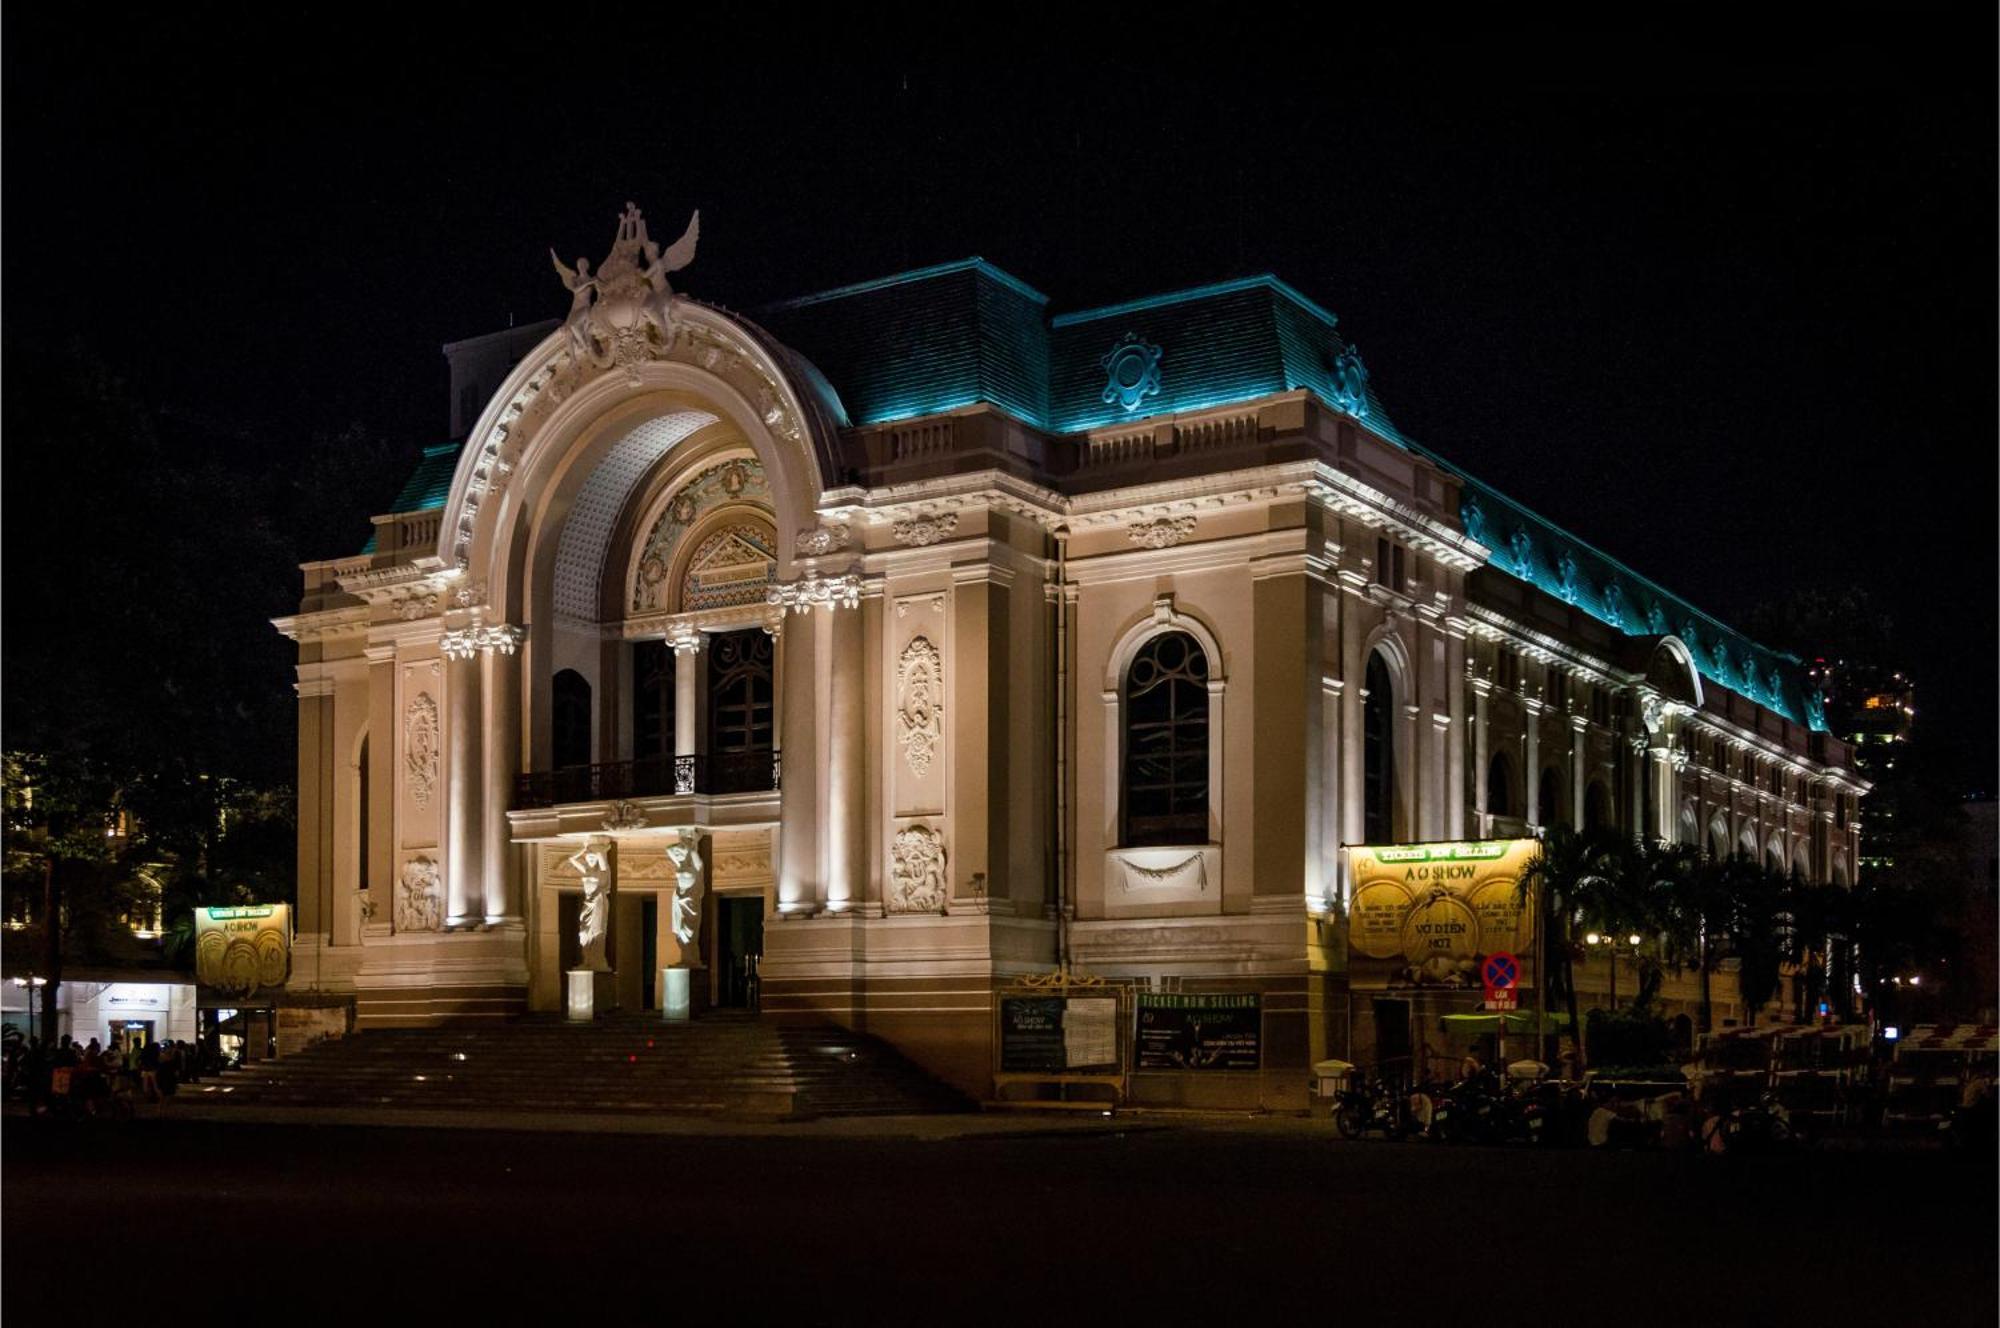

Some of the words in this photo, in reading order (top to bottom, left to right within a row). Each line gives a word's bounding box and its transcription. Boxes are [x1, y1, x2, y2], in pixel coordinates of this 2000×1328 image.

[1432, 865, 1477, 879] SHOW
[1143, 994, 1178, 1008] TICKET
[1212, 994, 1257, 1008] SELLING
